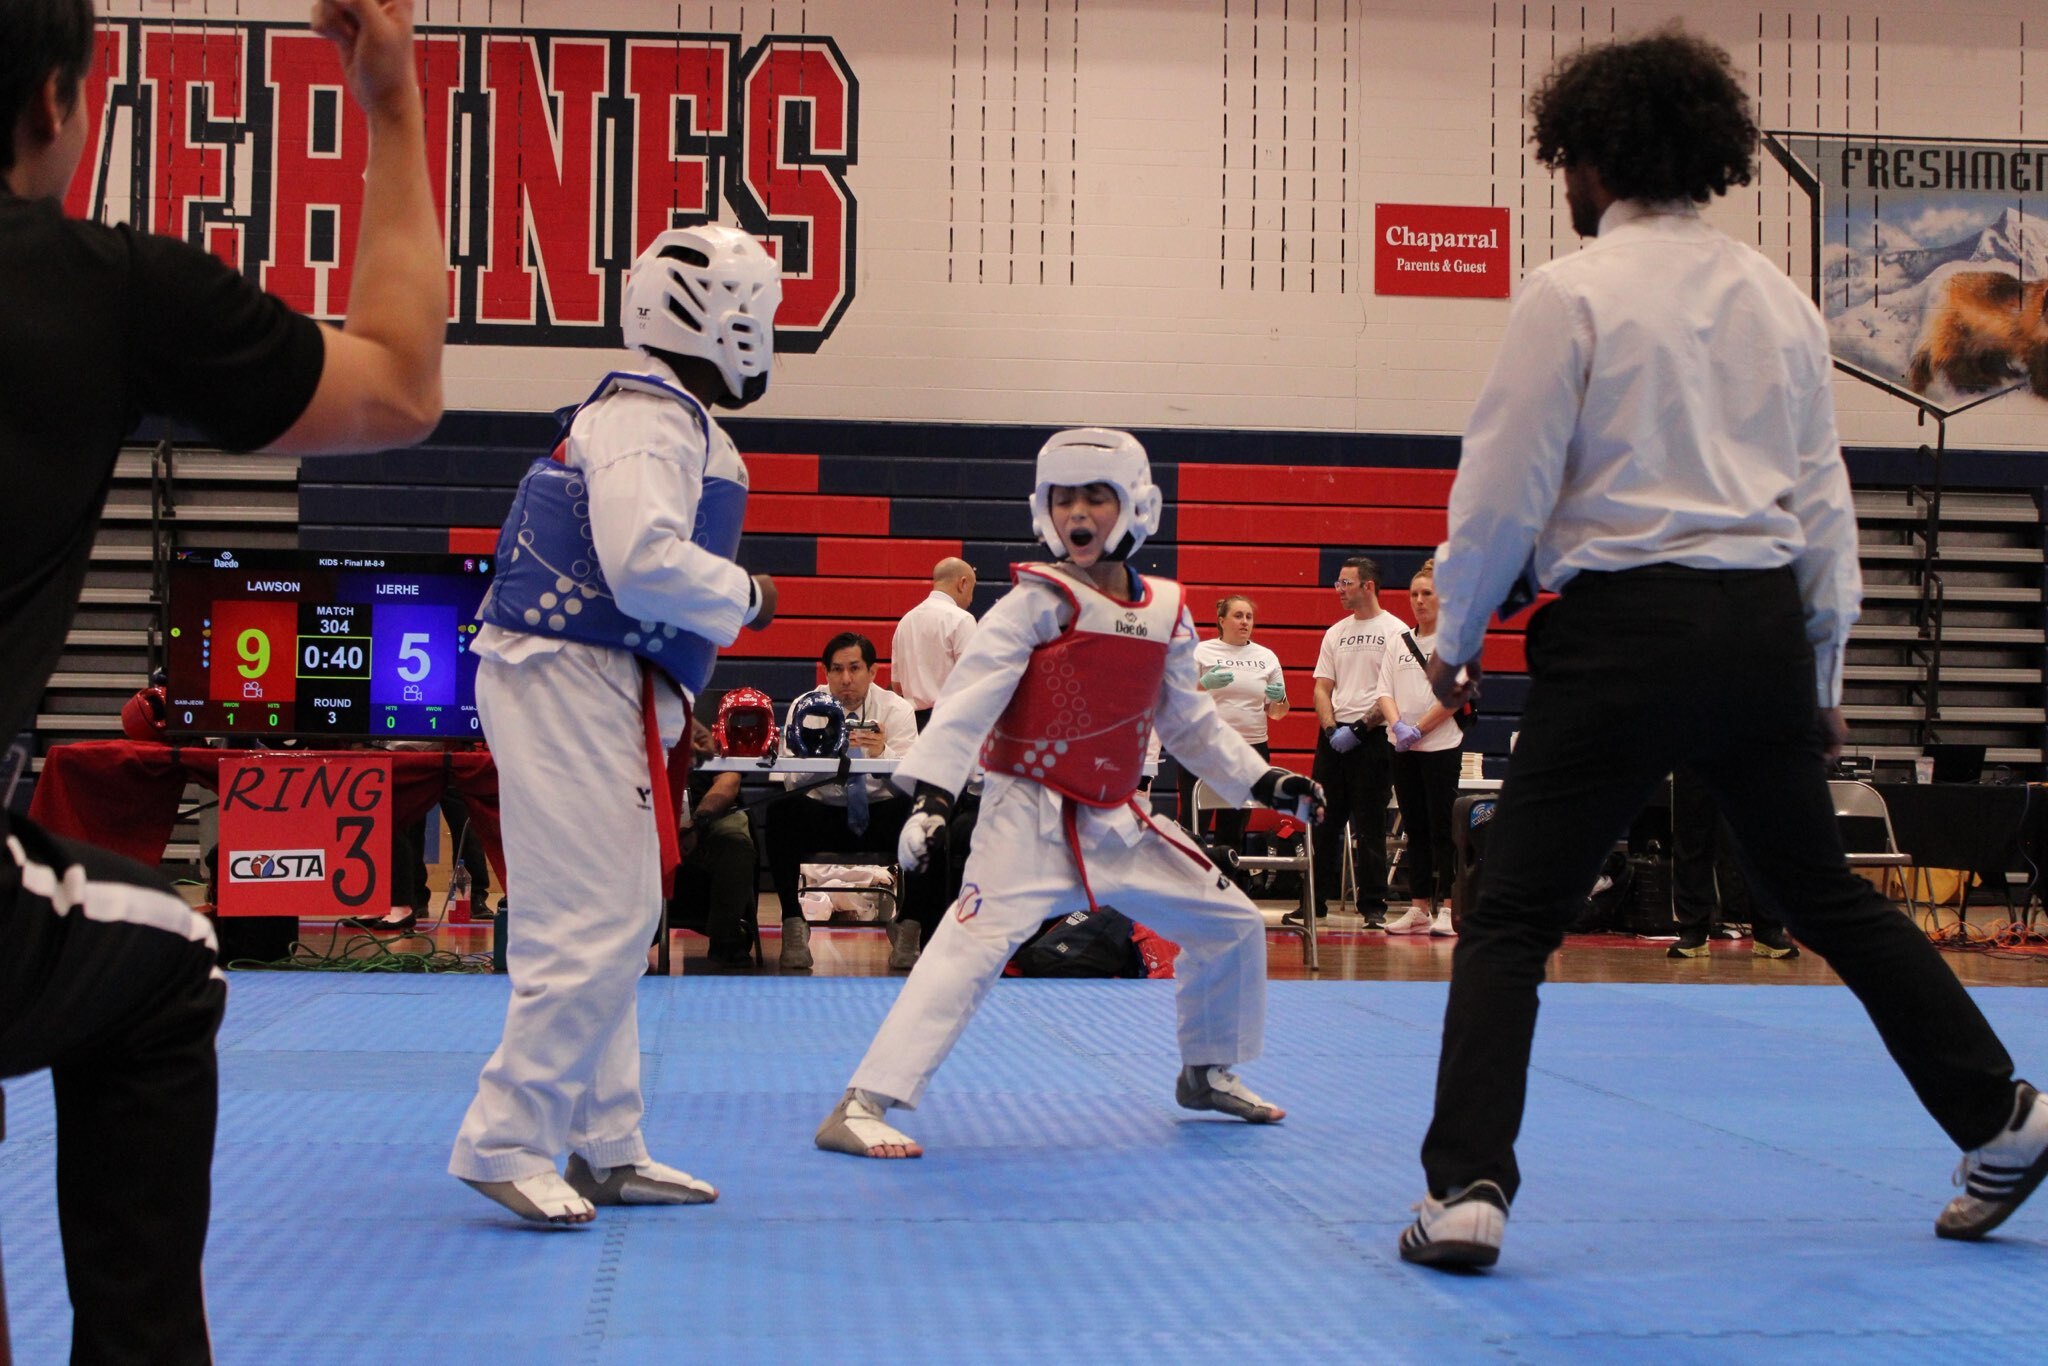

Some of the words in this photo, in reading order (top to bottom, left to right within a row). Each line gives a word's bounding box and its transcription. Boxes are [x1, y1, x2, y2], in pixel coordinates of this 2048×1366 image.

[1386, 225, 1499, 253] Chaparral
[1396, 258, 1440, 272] Parents
[1442, 259, 1451, 272] &
[1453, 259, 1487, 274] Guest
[214, 558, 239, 568] Daedo
[319, 558, 338, 566] KIDS
[344, 559, 363, 567] Final
[365, 560, 385, 568] M-8-9
[247, 581, 301, 592] LAWSON
[376, 584, 420, 595] IJERHE
[316, 606, 354, 616] MATCH
[320, 619, 350, 634] 304
[1339, 634, 1385, 646] FORTIS
[236, 628, 271, 679] 9
[304, 645, 363, 670] 0:40
[397, 632, 431, 682] 5
[1216, 659, 1266, 670] FORTIS
[313, 698, 352, 708] ROUND
[184, 711, 193, 724] 0
[227, 712, 234, 726] 1
[269, 713, 278, 726] 0
[327, 711, 337, 724] 3
[386, 716, 396, 729] 0
[429, 717, 437, 729] 1
[470, 717, 479, 730] 0
[223, 765, 386, 812] RING
[230, 853, 324, 880] COSTA
[332, 815, 377, 907] 3
